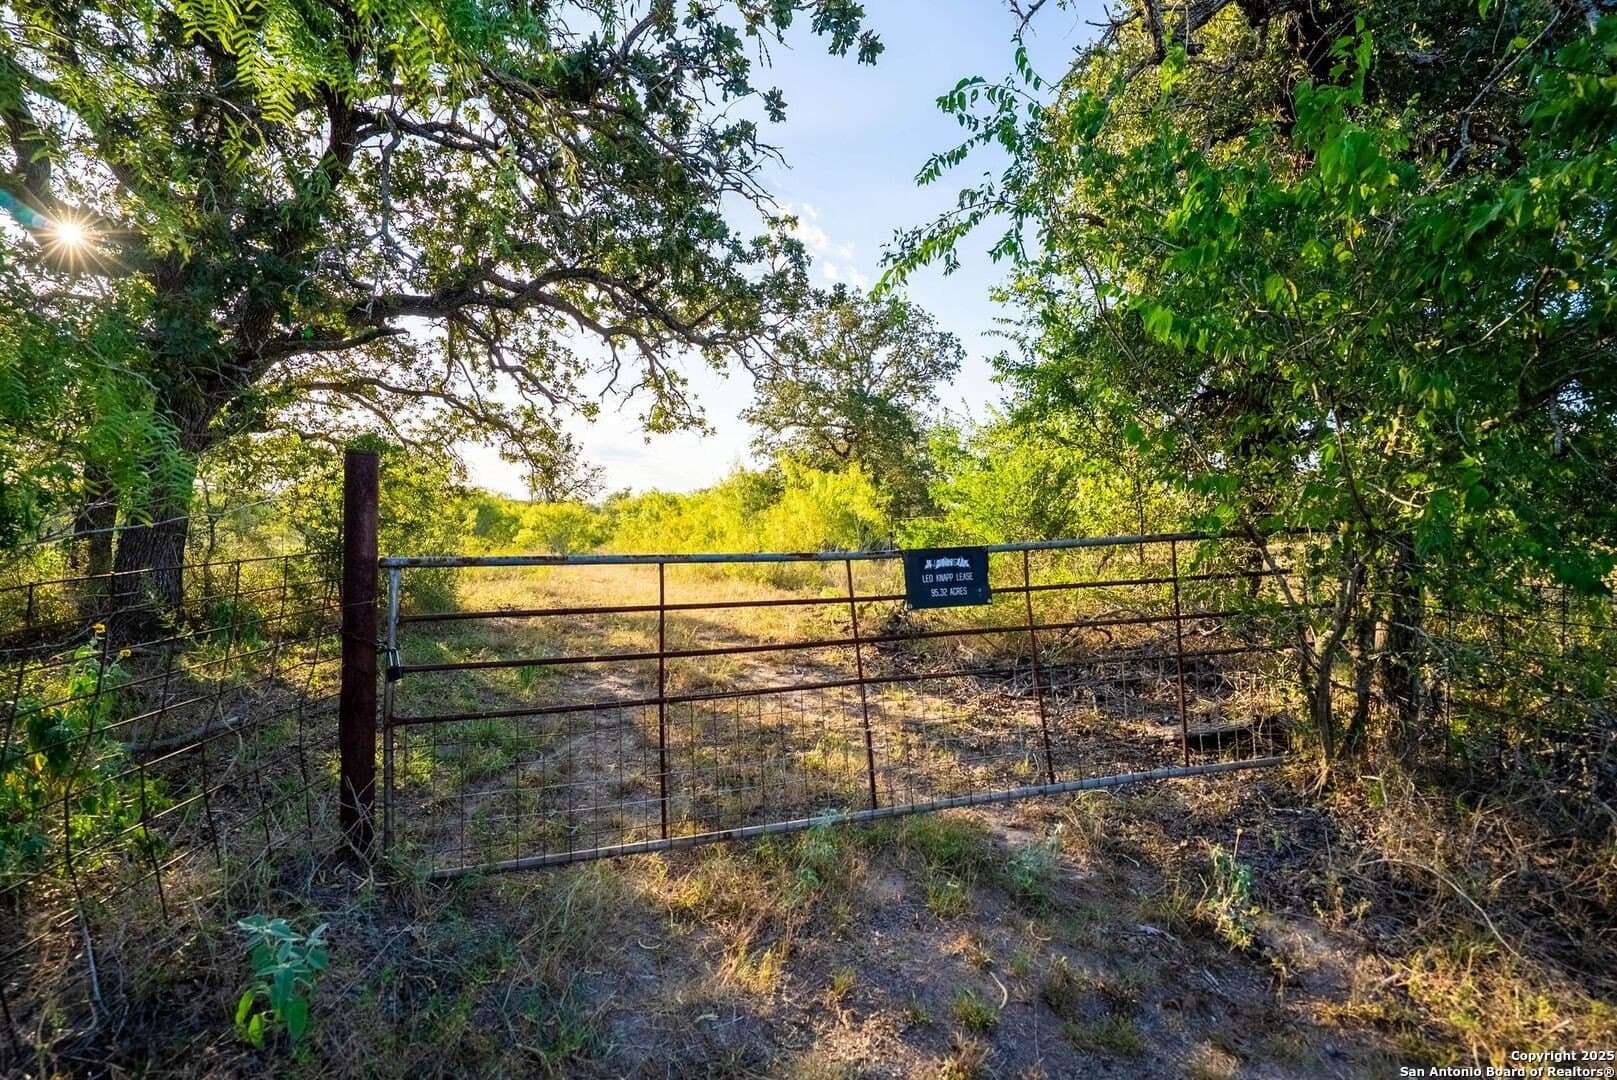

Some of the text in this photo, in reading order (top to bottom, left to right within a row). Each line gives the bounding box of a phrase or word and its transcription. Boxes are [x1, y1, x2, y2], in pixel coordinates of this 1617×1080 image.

[922, 572, 974, 583] LEO KNAPP LEASE
[930, 587, 968, 597] 95.32 ACRES
